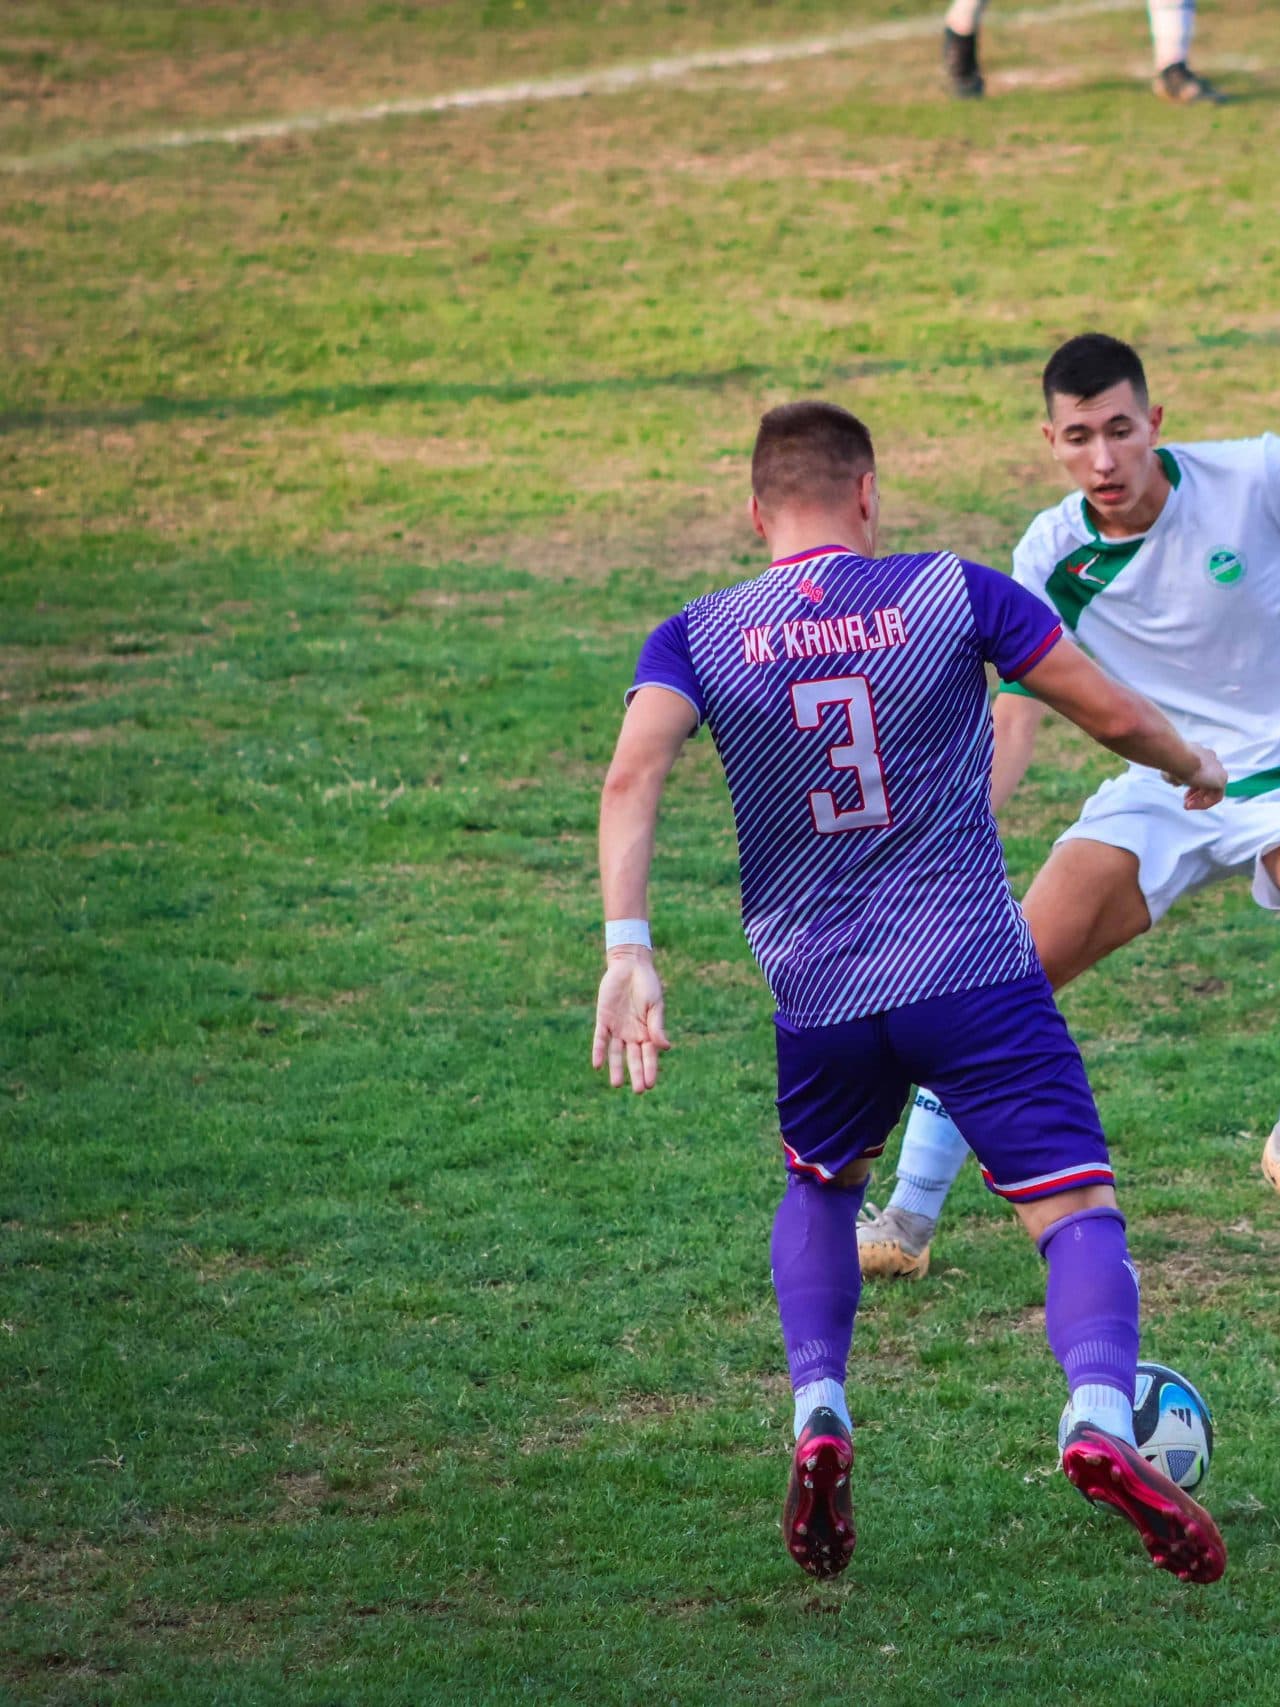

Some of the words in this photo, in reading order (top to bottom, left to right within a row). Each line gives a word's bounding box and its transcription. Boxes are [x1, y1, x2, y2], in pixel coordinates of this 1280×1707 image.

[741, 625, 776, 664] NK
[783, 607, 907, 659] KRIVAJA
[789, 674, 892, 835] 3
